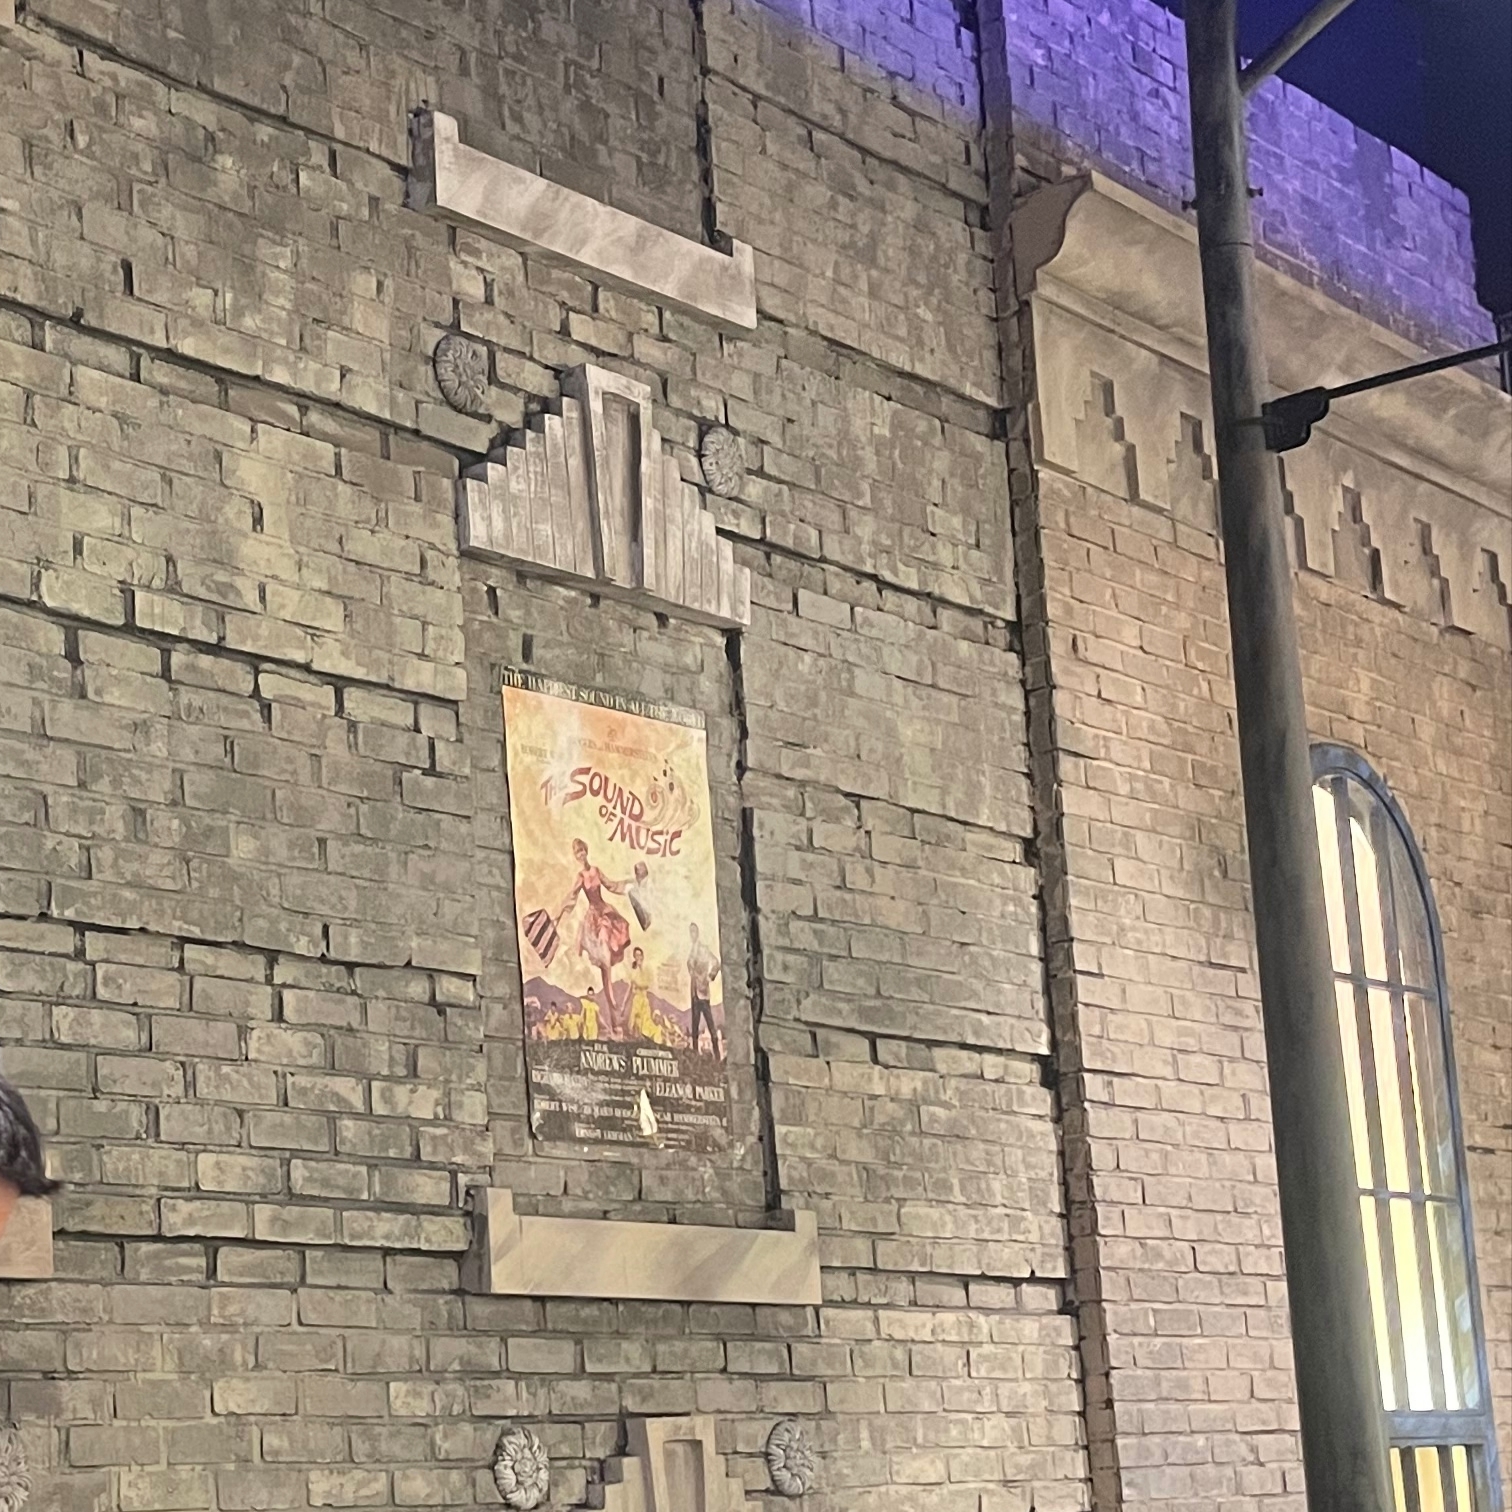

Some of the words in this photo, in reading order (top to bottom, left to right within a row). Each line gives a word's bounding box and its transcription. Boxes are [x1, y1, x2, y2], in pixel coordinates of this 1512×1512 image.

[563, 767, 644, 823] SOUND
[599, 805, 617, 824] OF
[580, 1050, 626, 1072] ANDREWS
[632, 1056, 679, 1078] PLUMMER
